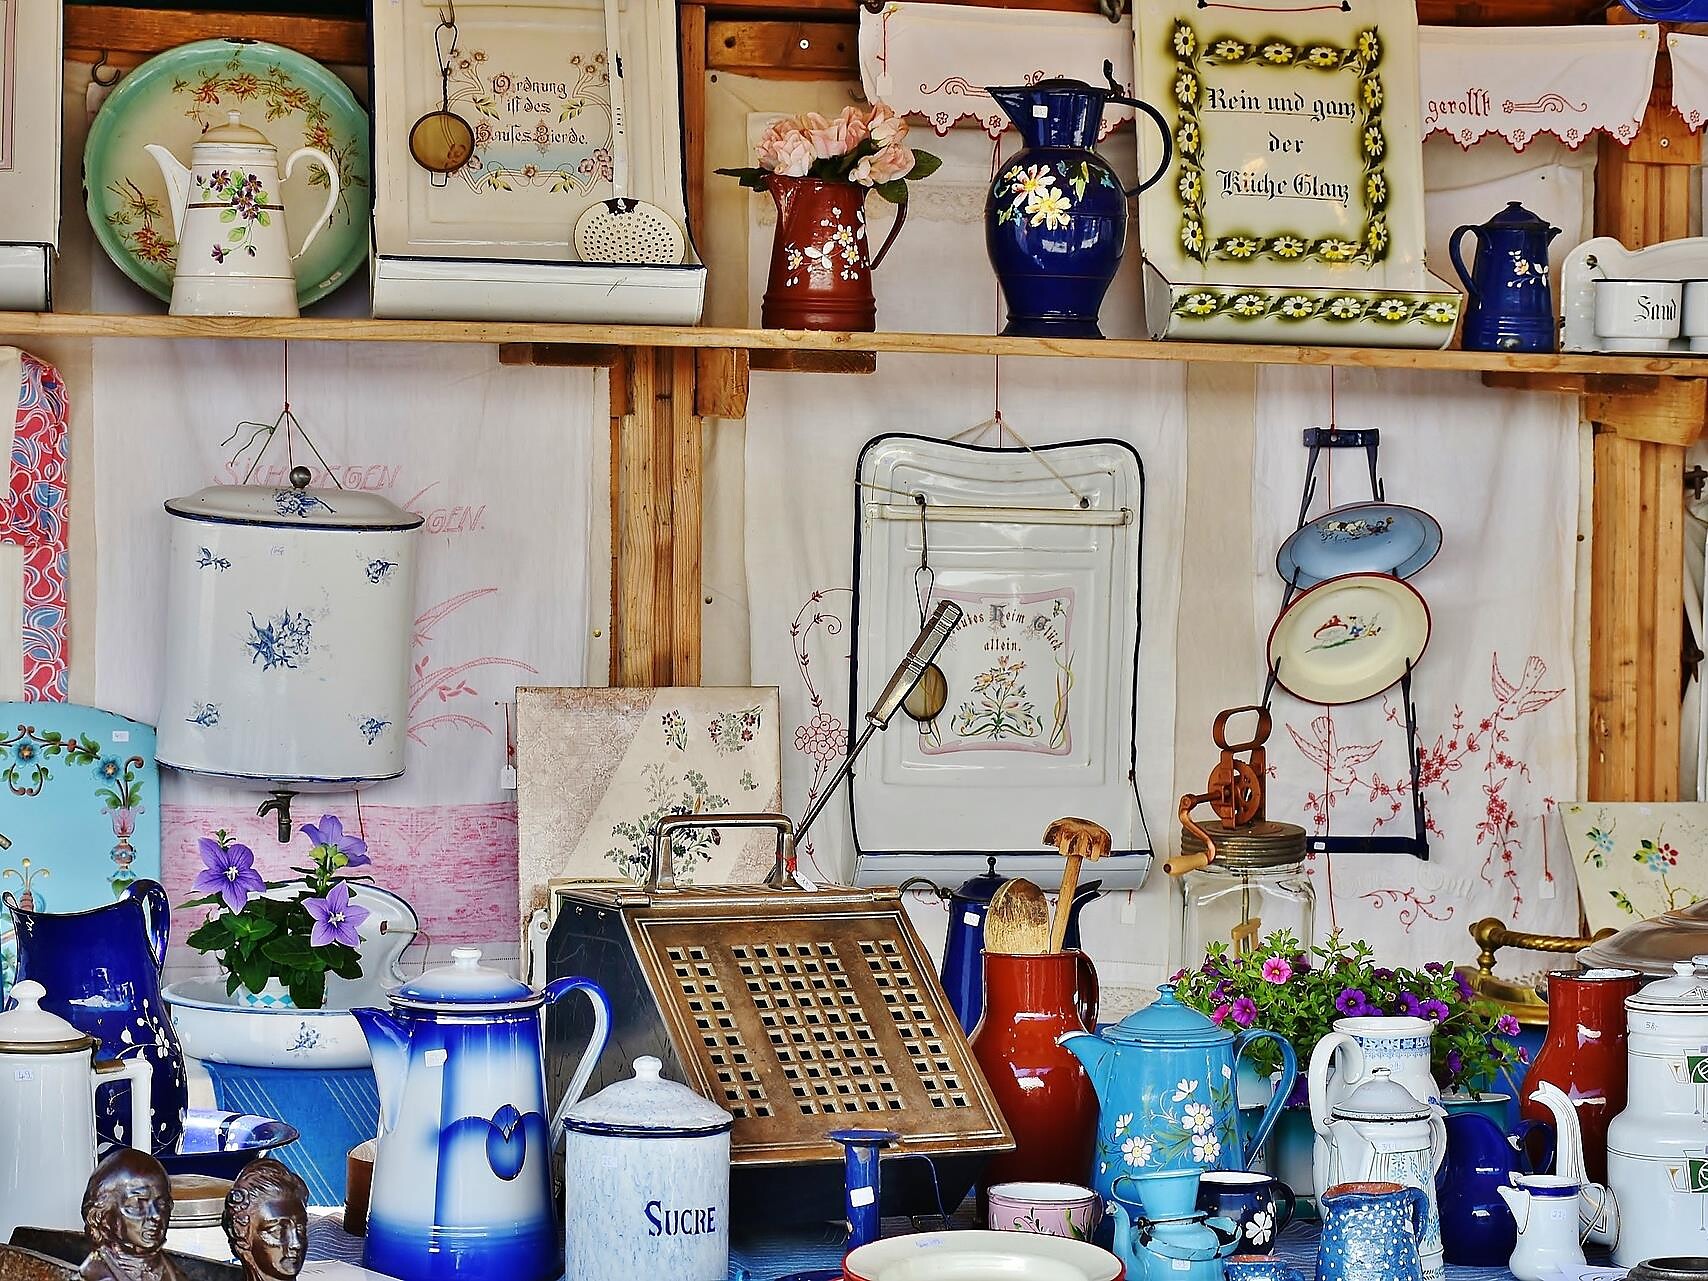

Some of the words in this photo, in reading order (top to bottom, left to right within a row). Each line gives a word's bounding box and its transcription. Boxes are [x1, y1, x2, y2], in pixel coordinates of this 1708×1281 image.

[493, 75, 567, 99] Ordnung
[524, 97, 551, 112] des
[1206, 87, 1260, 110] Rein
[1267, 91, 1305, 112] und
[1311, 99, 1355, 123] ganz
[1268, 131, 1304, 153] der
[1216, 169, 1287, 200] Küche
[1293, 172, 1349, 208] Glanz
[1634, 295, 1677, 322] Sand
[953, 612, 985, 634] autes
[989, 604, 1025, 628] Heim
[1033, 615, 1063, 651] Glück
[984, 637, 1021, 652] allein.
[644, 1200, 716, 1237] SUCRE
